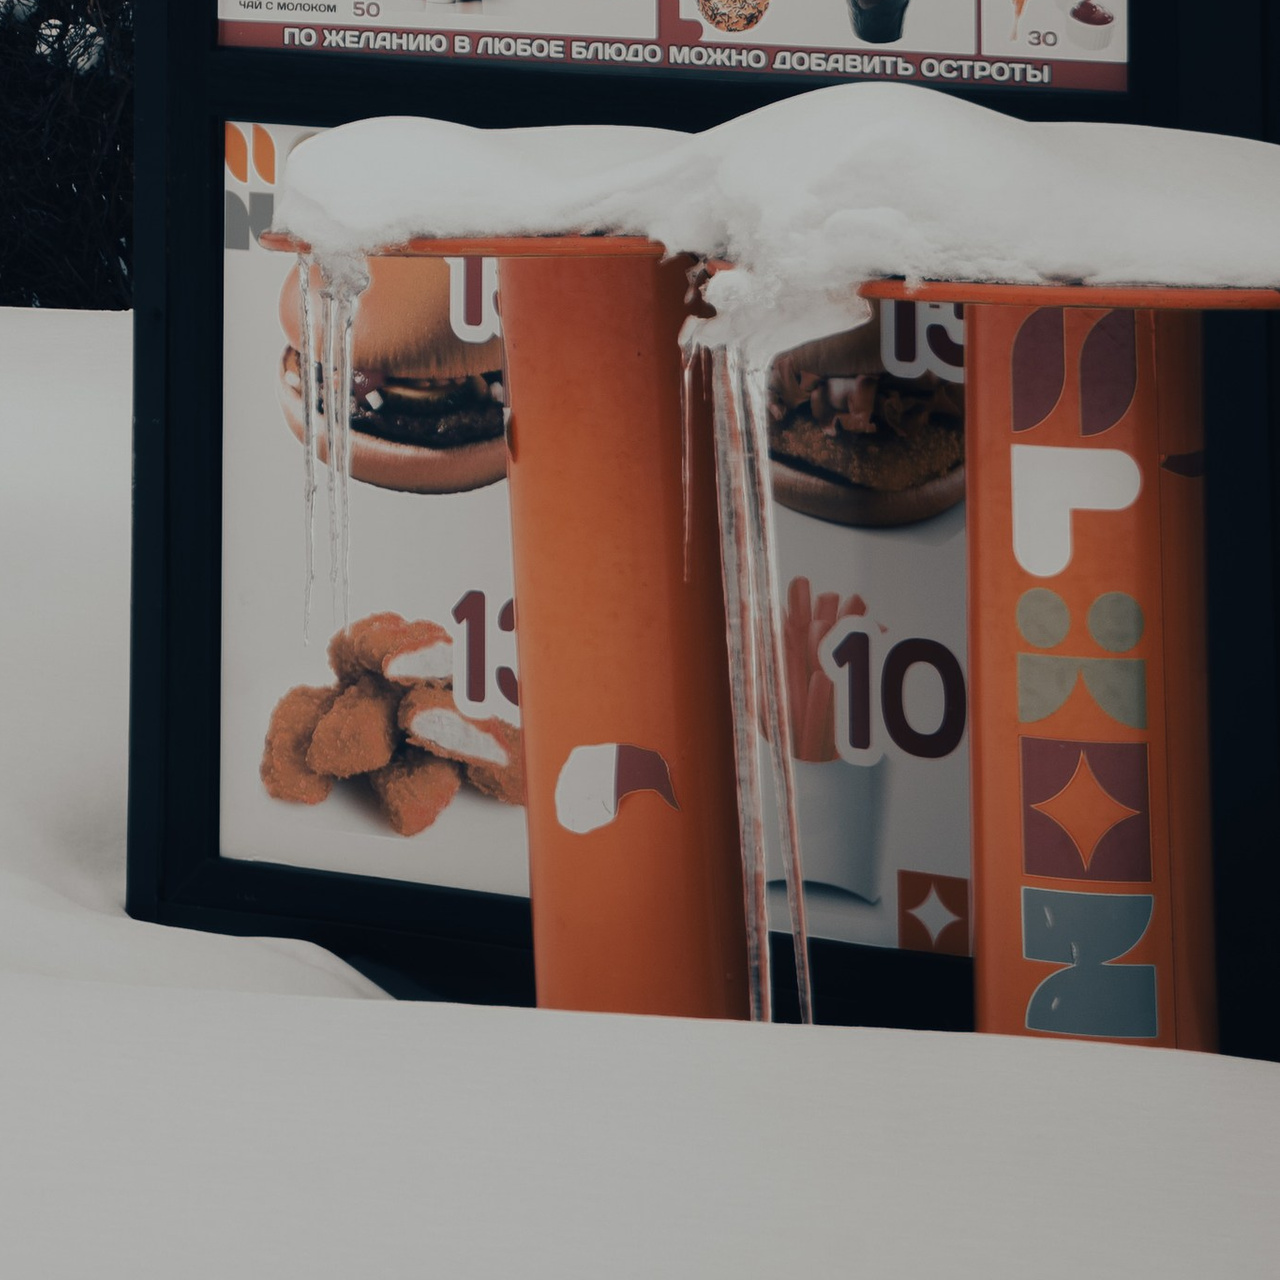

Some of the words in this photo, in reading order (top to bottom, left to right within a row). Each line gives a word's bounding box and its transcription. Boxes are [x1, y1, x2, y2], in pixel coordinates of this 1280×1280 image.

[239, 0, 262, 10] ЧАЙ
[277, 2, 337, 13] МОЛОКОМ
[352, 2, 380, 18] 50
[1028, 31, 1057, 47] 30
[283, 28, 317, 47] ПО
[322, 29, 447, 54] ЖЕЛАНИЮ
[454, 36, 470, 54] В
[476, 36, 564, 59] ЛЮБОЕ
[572, 42, 662, 65] БЛЮДО
[669, 46, 766, 69] МОЖНО
[773, 51, 913, 77] ДОБАВИТЬ
[920, 58, 1051, 83] ОСТРОТЫ
